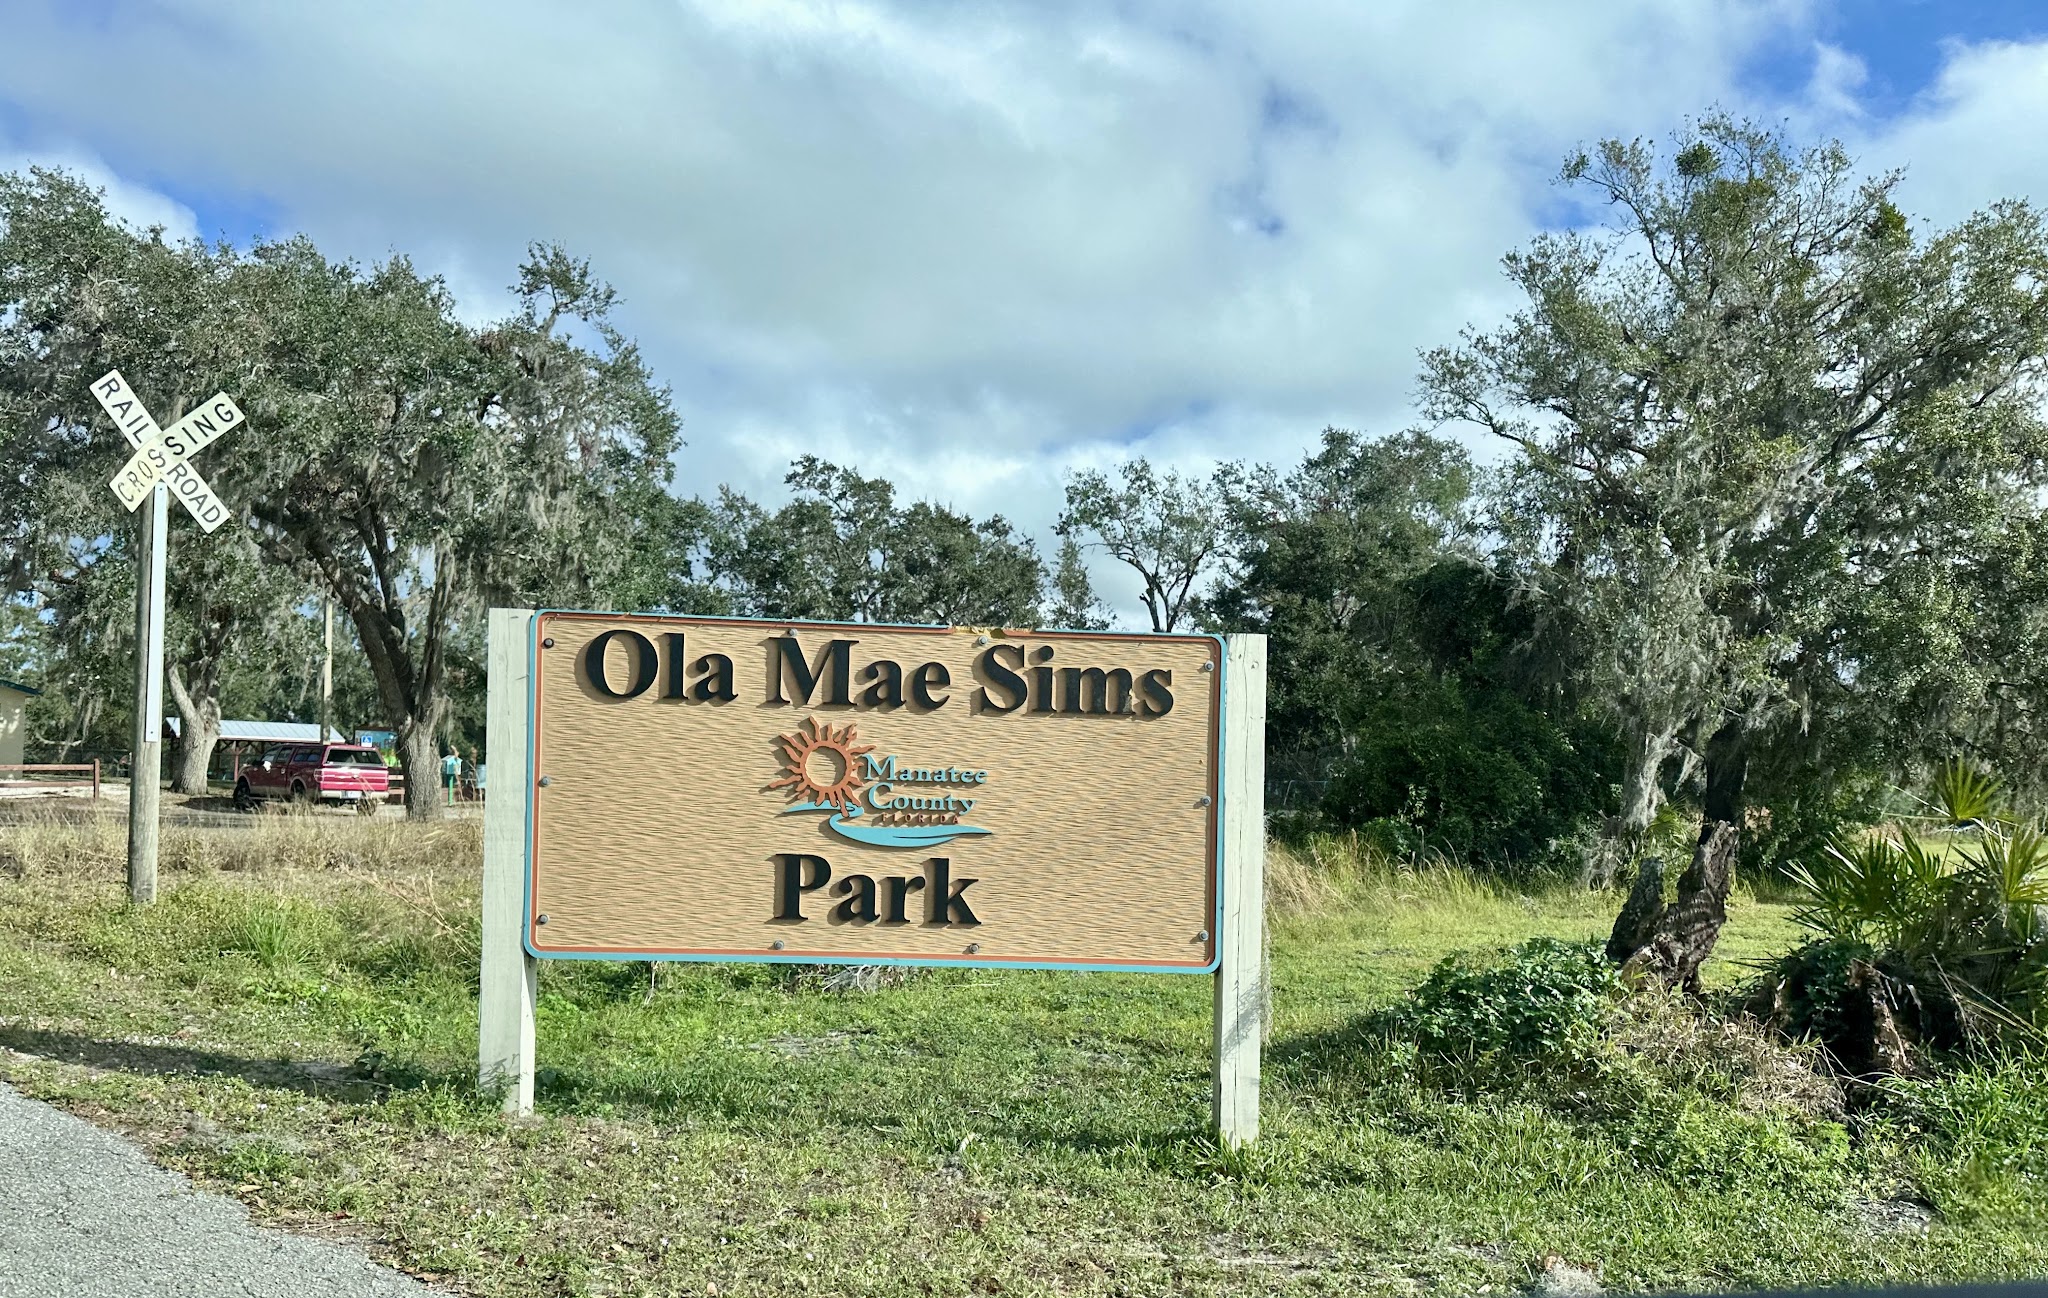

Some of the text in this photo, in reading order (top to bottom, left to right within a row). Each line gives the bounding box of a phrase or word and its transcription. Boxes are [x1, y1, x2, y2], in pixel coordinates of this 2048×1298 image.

[98, 377, 221, 523] RAIL ROAD
[117, 403, 234, 502] CROSSING
[585, 629, 1174, 717] Ola Mae Sims
[862, 754, 988, 784] Manatee
[868, 782, 977, 815] County
[882, 812, 960, 824] FLORIDA
[774, 853, 982, 925] Park
